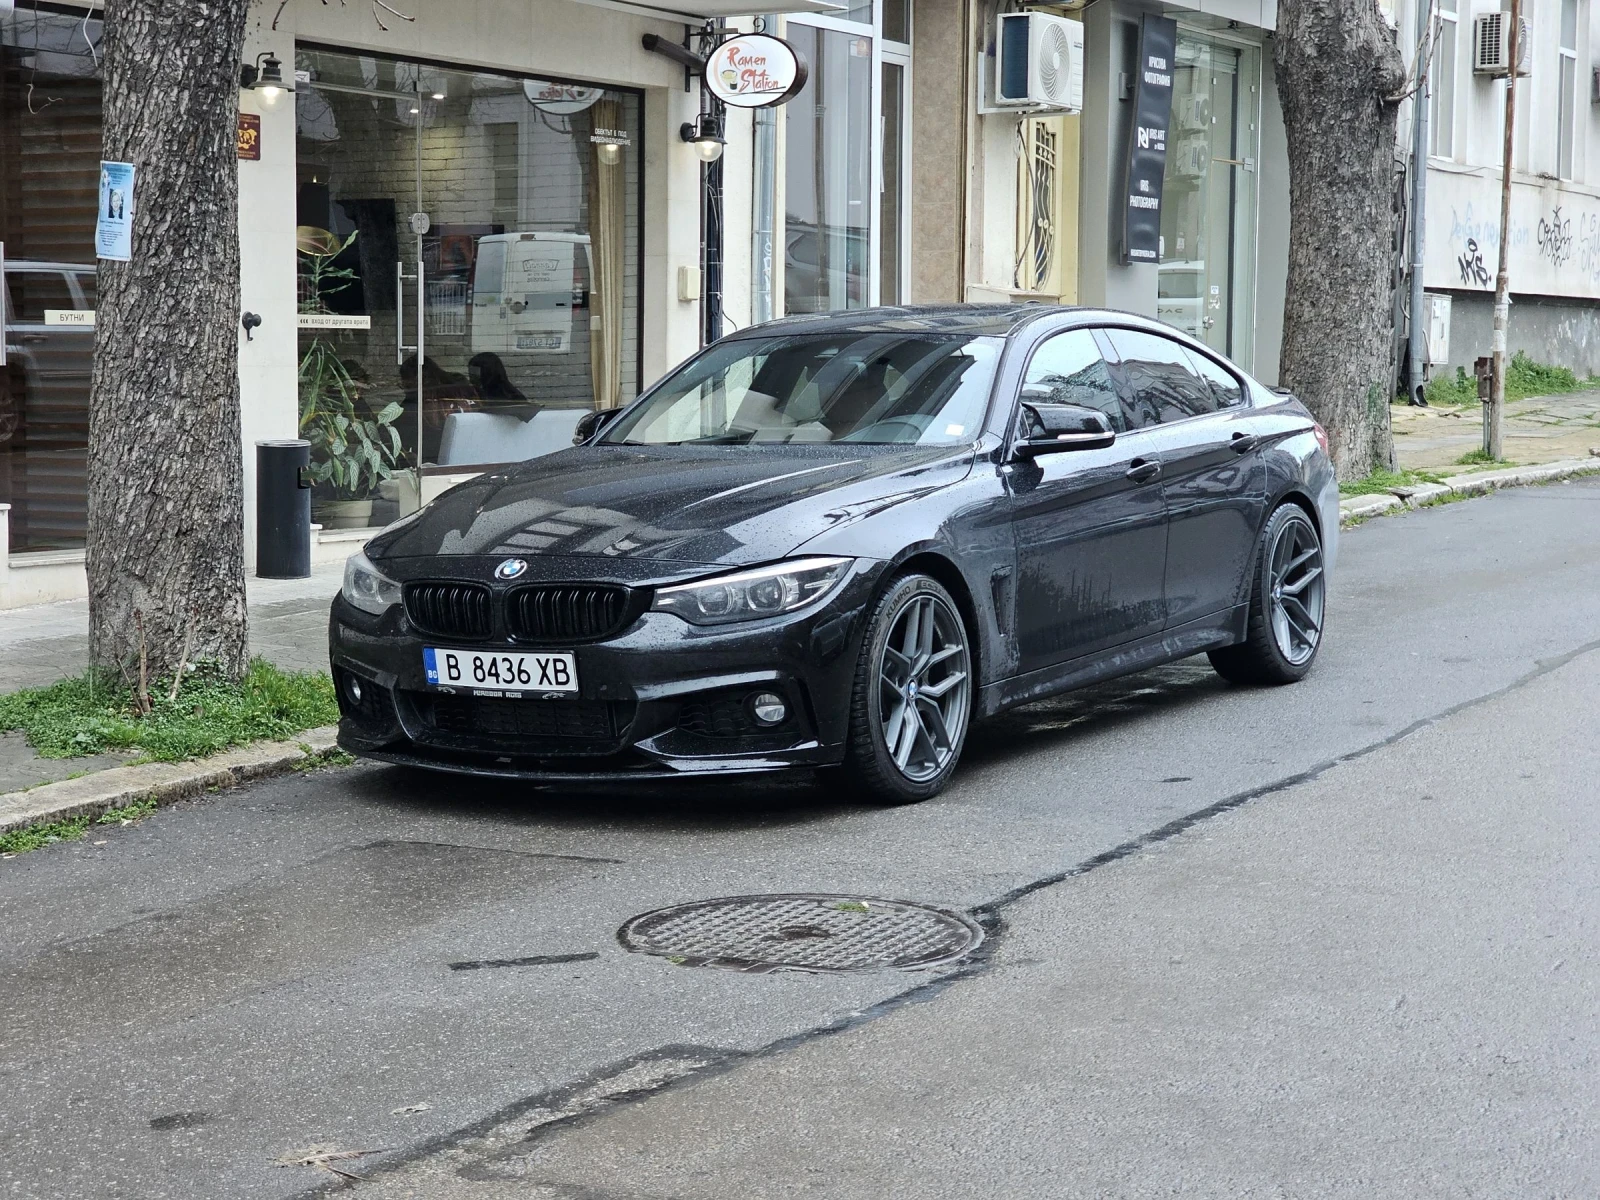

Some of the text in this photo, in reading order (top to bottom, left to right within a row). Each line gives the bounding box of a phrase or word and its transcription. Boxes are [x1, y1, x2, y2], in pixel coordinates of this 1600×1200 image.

[727, 46, 766, 71] Ramen
[739, 68, 779, 92] Station
[594, 128, 613, 136] ОБЕКТЪТ
[617, 130, 627, 138] ПОД
[590, 136, 631, 146] ВИДЕОНАБЛЮДЕНИЕ
[1140, 179, 1149, 192] IRIS
[1129, 195, 1159, 210] PHOTOGRAPHY
[60, 313, 85, 322] БУТНИ
[886, 585, 911, 620] KUMHO
[428, 669, 438, 679] BG
[446, 653, 570, 686] B 8436 XB
